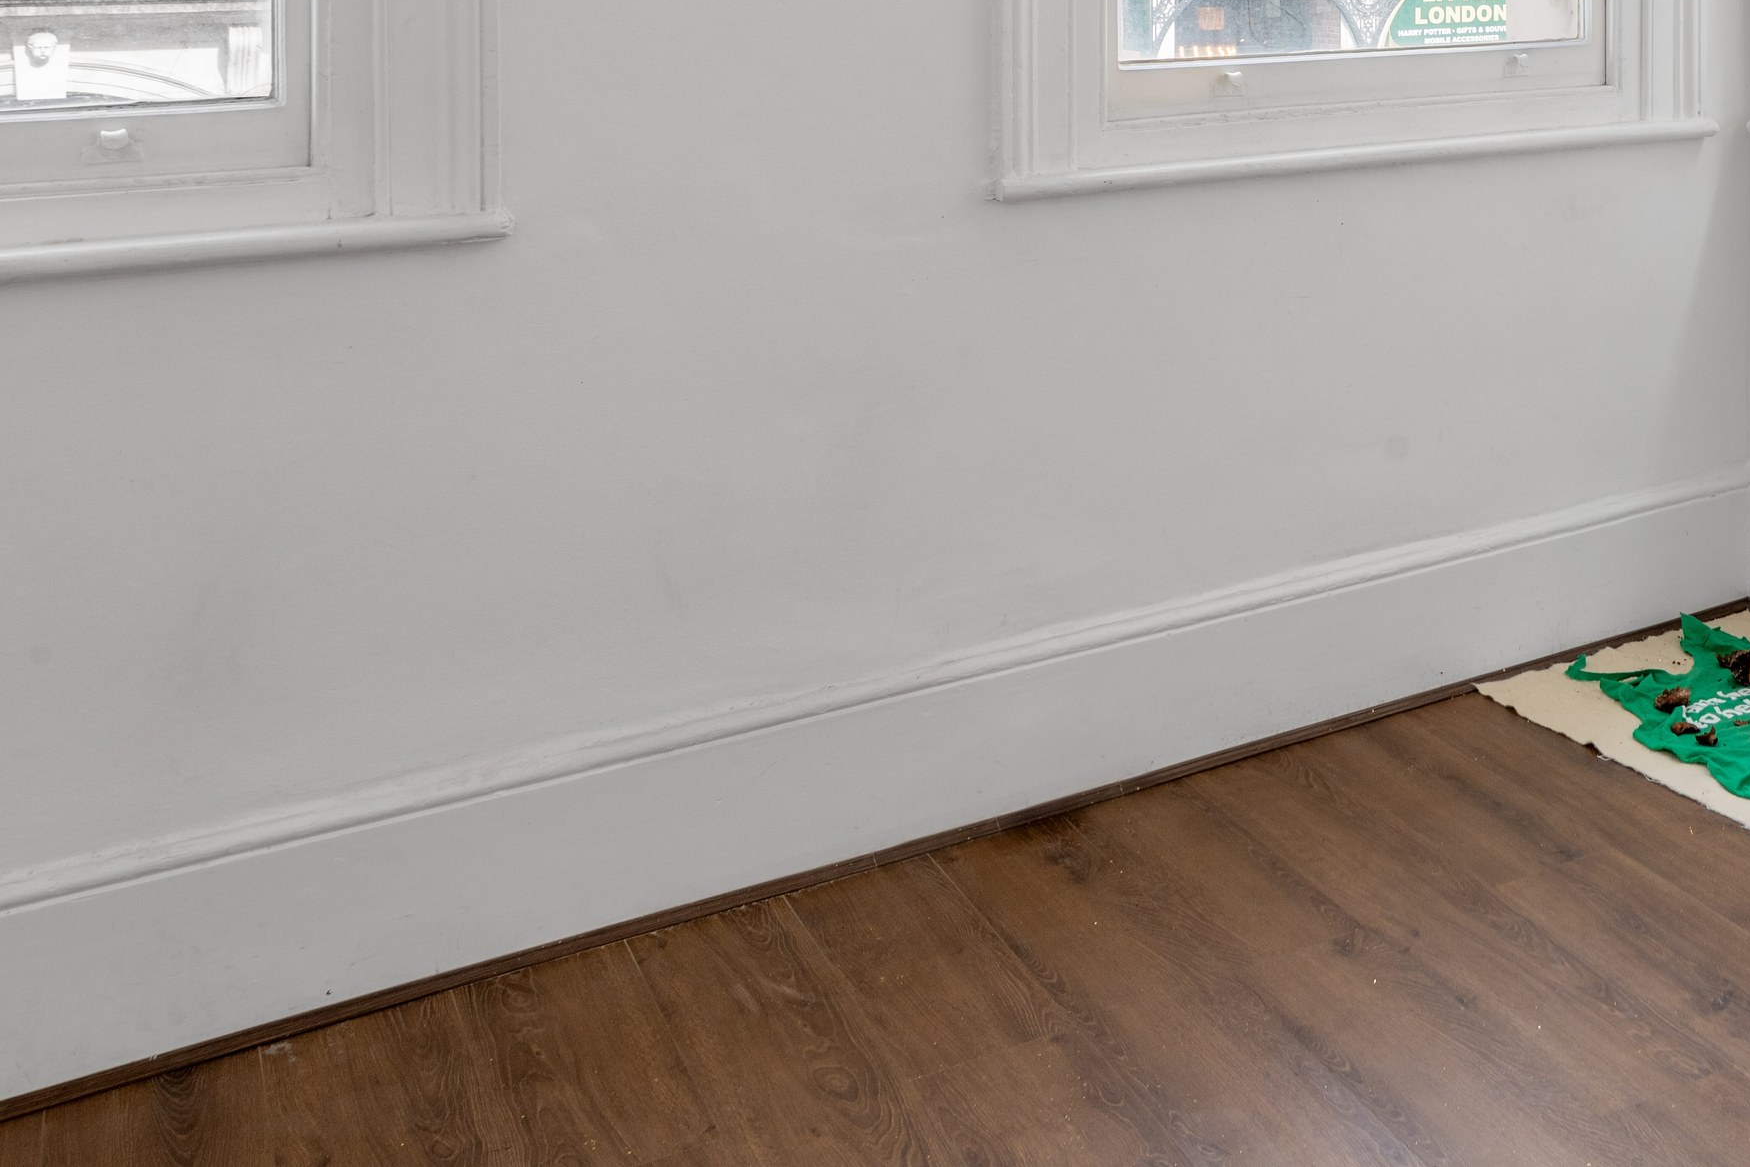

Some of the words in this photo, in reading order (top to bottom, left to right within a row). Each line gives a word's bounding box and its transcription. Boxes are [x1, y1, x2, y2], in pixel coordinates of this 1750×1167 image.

[1414, 4, 1506, 24] LONDON
[1398, 29, 1422, 37] HARRY
[1424, 28, 1452, 36] POTTER
[1456, 26, 1478, 34] GIFTS
[1424, 36, 1451, 44] MOBILE
[1452, 34, 1500, 43] ACCESSORIES
[1685, 712, 1721, 729] to
